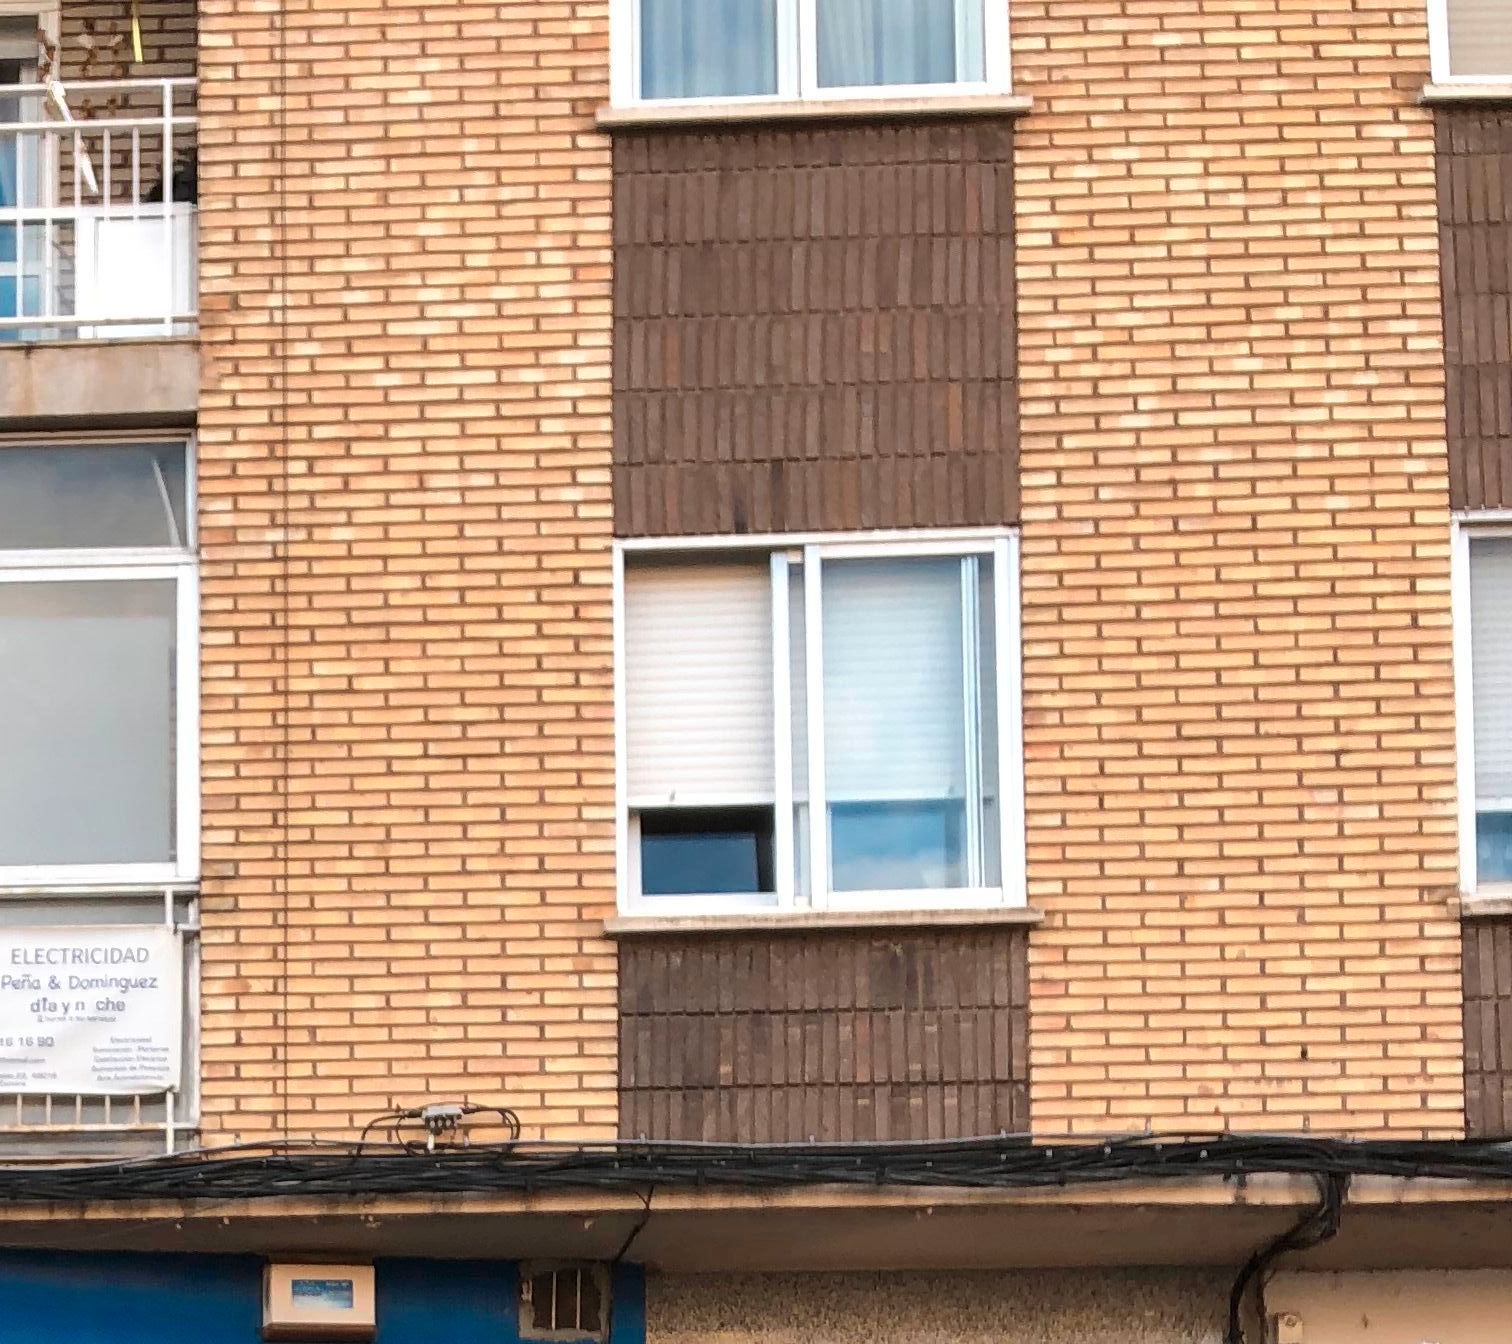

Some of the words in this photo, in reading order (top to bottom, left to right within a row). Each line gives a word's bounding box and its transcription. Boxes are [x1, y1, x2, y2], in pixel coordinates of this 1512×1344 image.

[10, 947, 150, 965] ELECTRICIDAD
[1, 974, 41, 990] Peña
[48, 974, 61, 990] &
[61, 1000, 70, 1015] y
